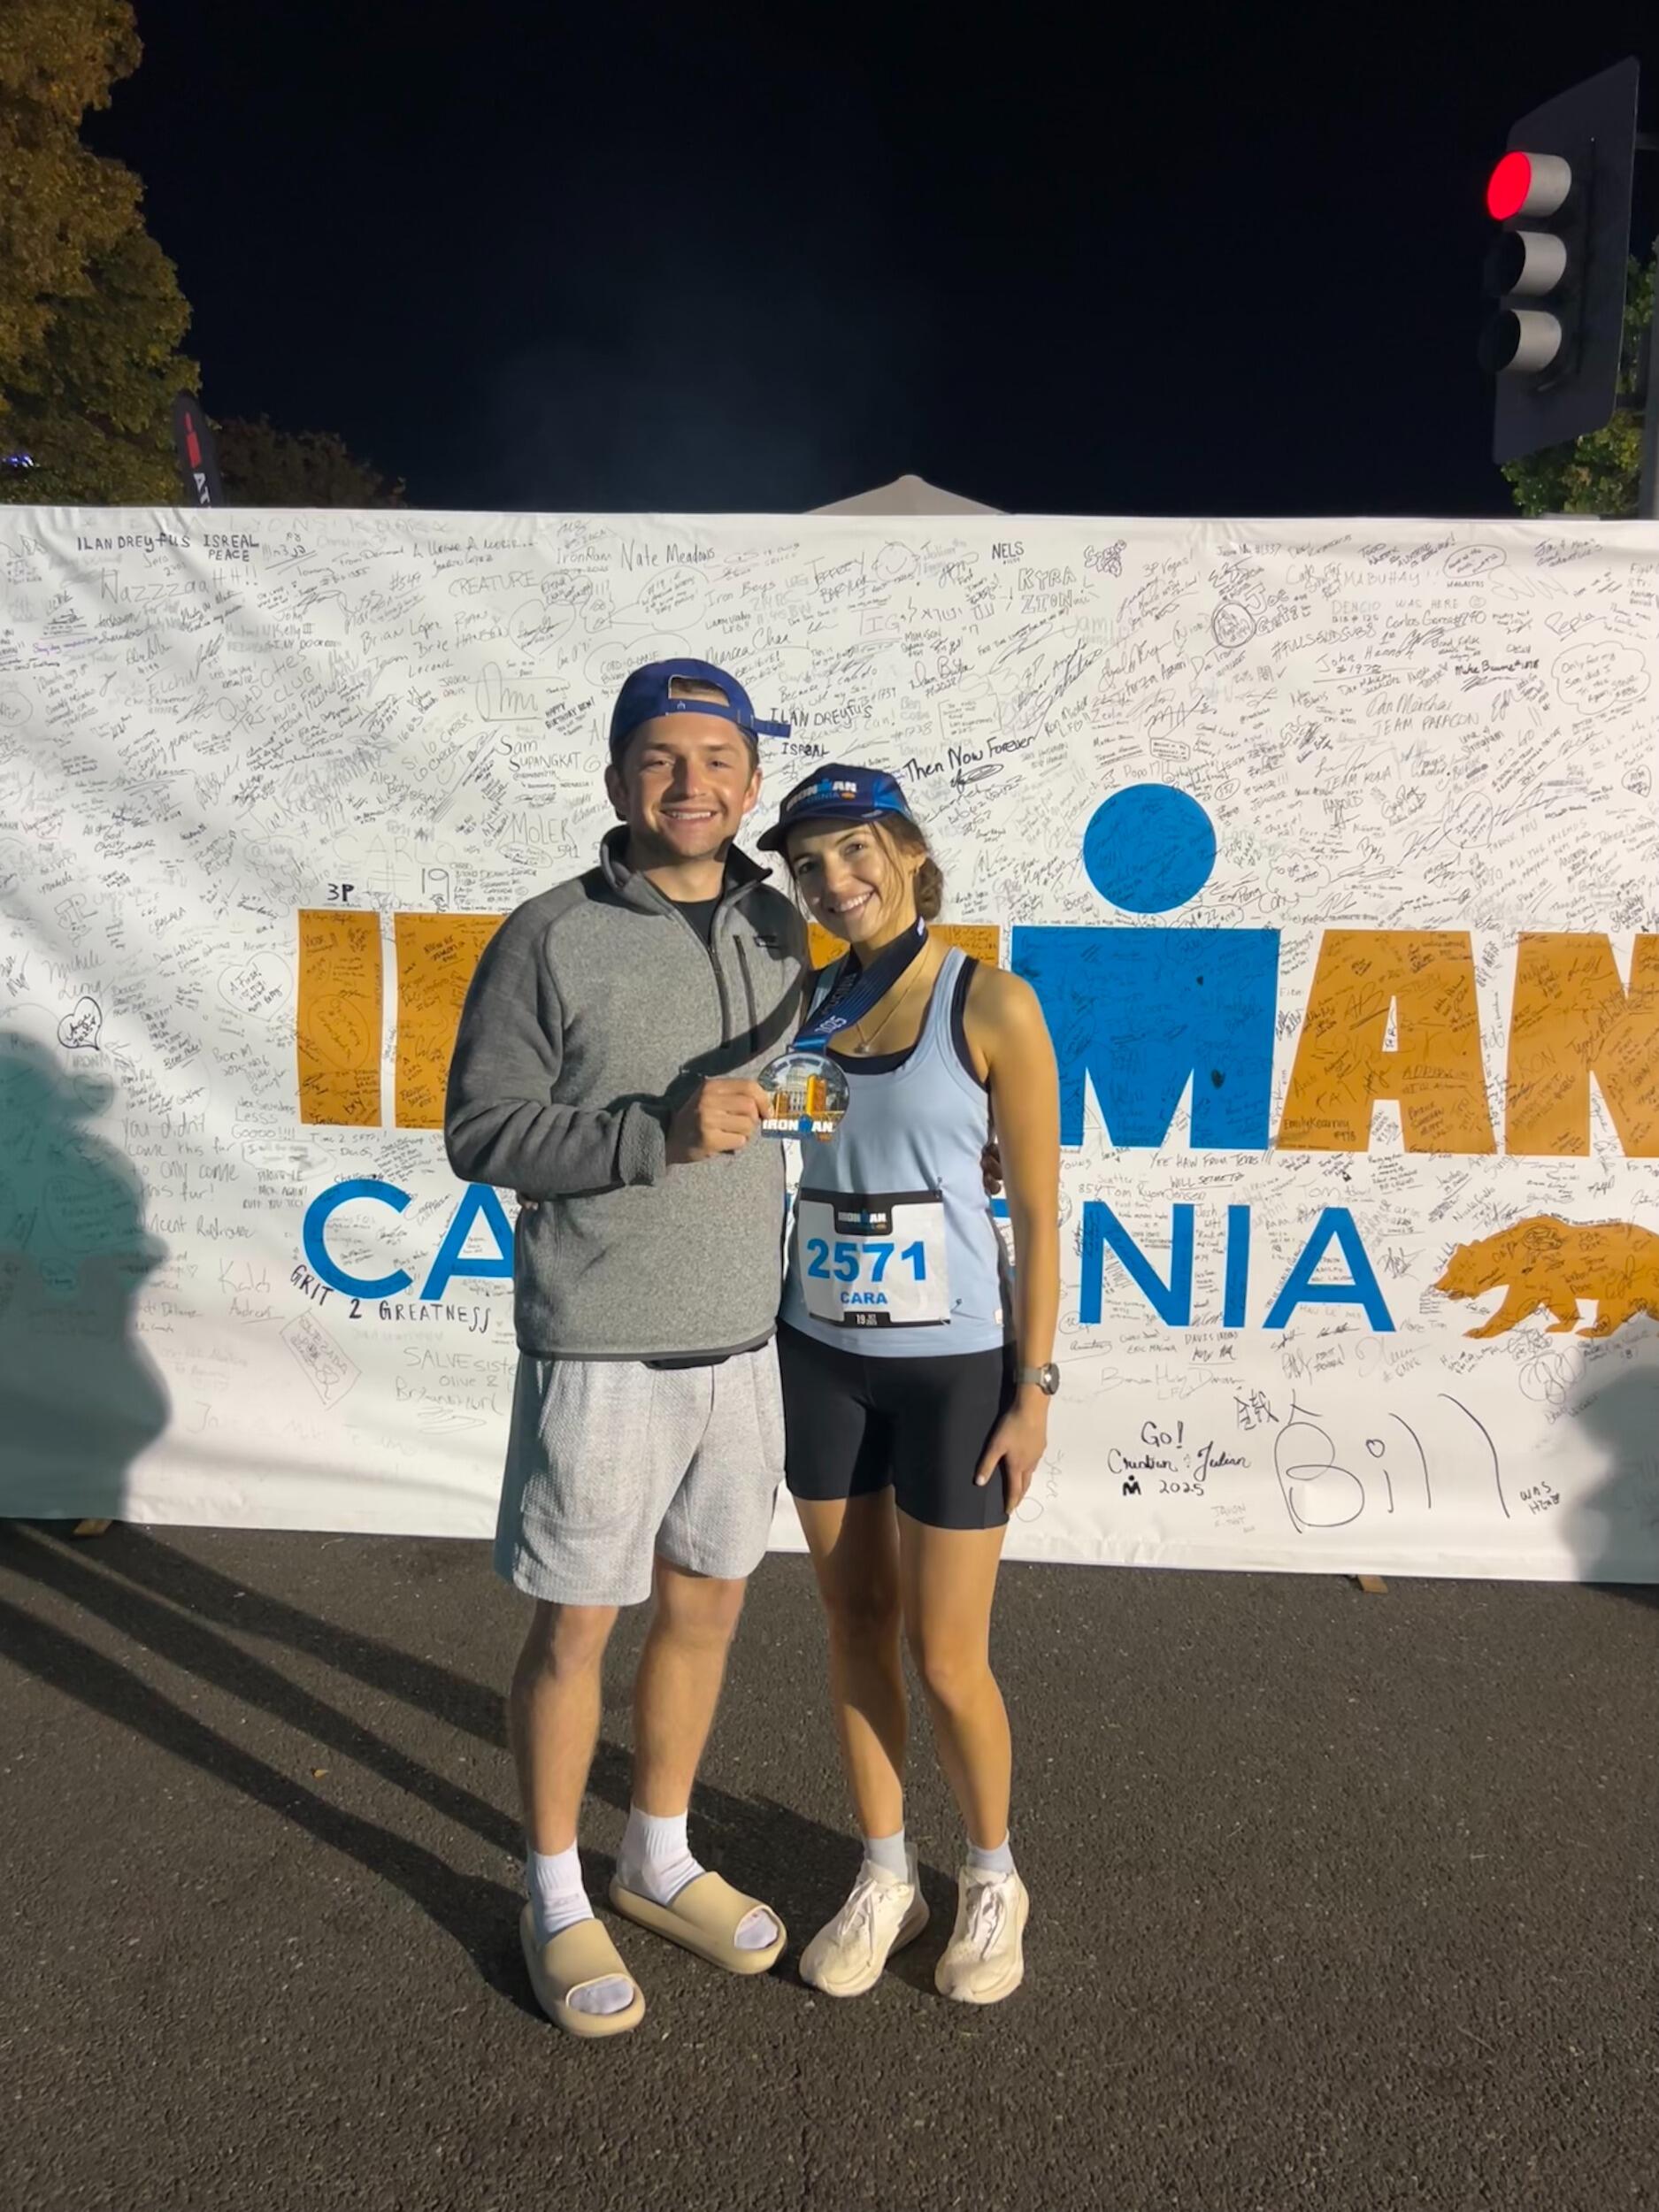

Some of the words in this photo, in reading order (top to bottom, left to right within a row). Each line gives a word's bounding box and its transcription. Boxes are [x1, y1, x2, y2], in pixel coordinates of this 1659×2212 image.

[193, 472, 212, 509] AT
[77, 536, 112, 550] ILAN
[203, 534, 259, 549] ISREAL
[992, 541, 1025, 559] NELS
[208, 549, 250, 562] PEACE
[621, 538, 658, 572] Nate
[665, 543, 715, 564] Meadows
[449, 570, 539, 597] CREATURE
[1018, 565, 1077, 591] KYRA
[771, 707, 810, 727] ILAN
[499, 733, 538, 756] Sam
[507, 751, 581, 773] SUPANGKAT
[902, 757, 944, 782] Then
[948, 745, 984, 769] Now
[326, 883, 355, 902] 3P
[806, 1237, 927, 1283] 2571
[290, 1264, 334, 1307] GRIT
[349, 1297, 363, 1319] 2
[379, 1300, 492, 1334] GREATNESS
[840, 1291, 888, 1305] CARA
[1141, 1420, 1184, 1448] Go!
[1275, 1393, 1510, 1534] Bill
[1159, 1479, 1204, 1496] 2025
[1519, 1481, 1552, 1502] WAS
